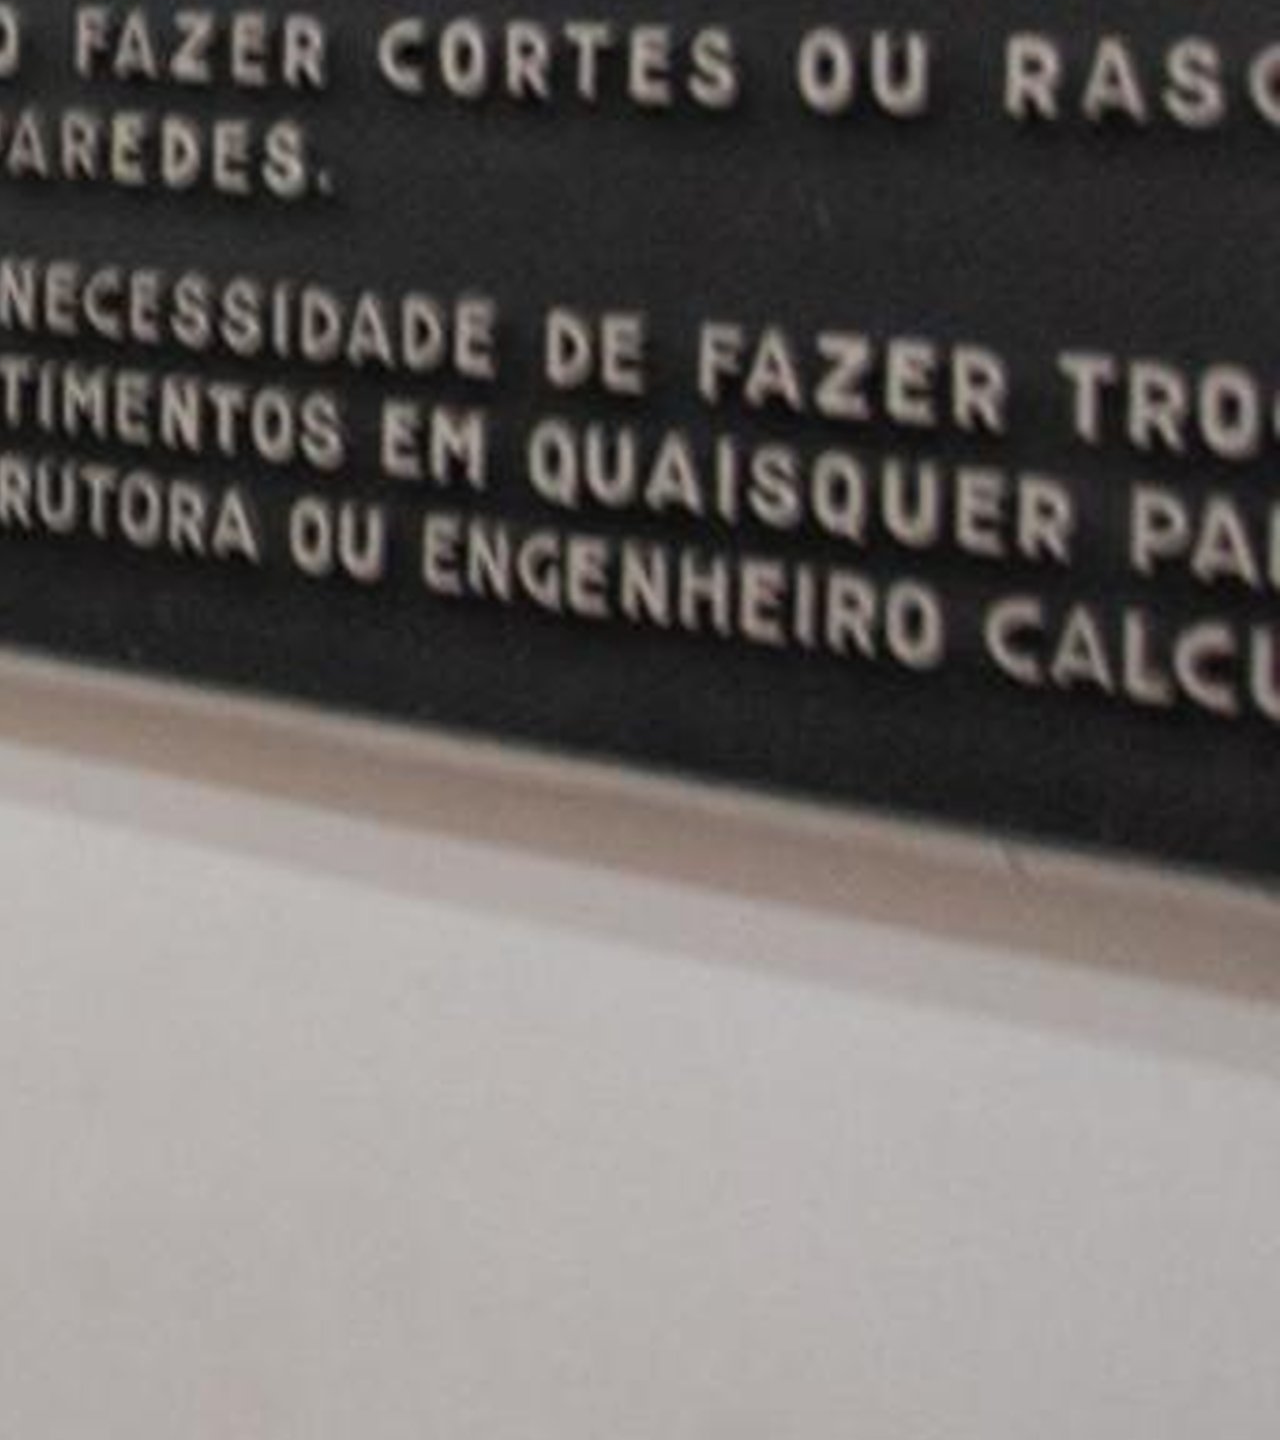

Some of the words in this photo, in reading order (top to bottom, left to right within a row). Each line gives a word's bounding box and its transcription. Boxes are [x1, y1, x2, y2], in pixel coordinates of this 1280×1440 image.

[73, 5, 327, 90] FAZER
[376, 17, 738, 110] CORTES
[797, 24, 930, 118] OU
[545, 304, 643, 395] DE
[698, 318, 1004, 436] FAZER
[1056, 348, 1280, 462] TRO
[380, 392, 488, 493] EM
[528, 418, 1071, 570] QUAISQUER
[1130, 478, 1280, 596] PA
[288, 496, 386, 584] OU
[421, 512, 943, 671] ENGENHEIRO
